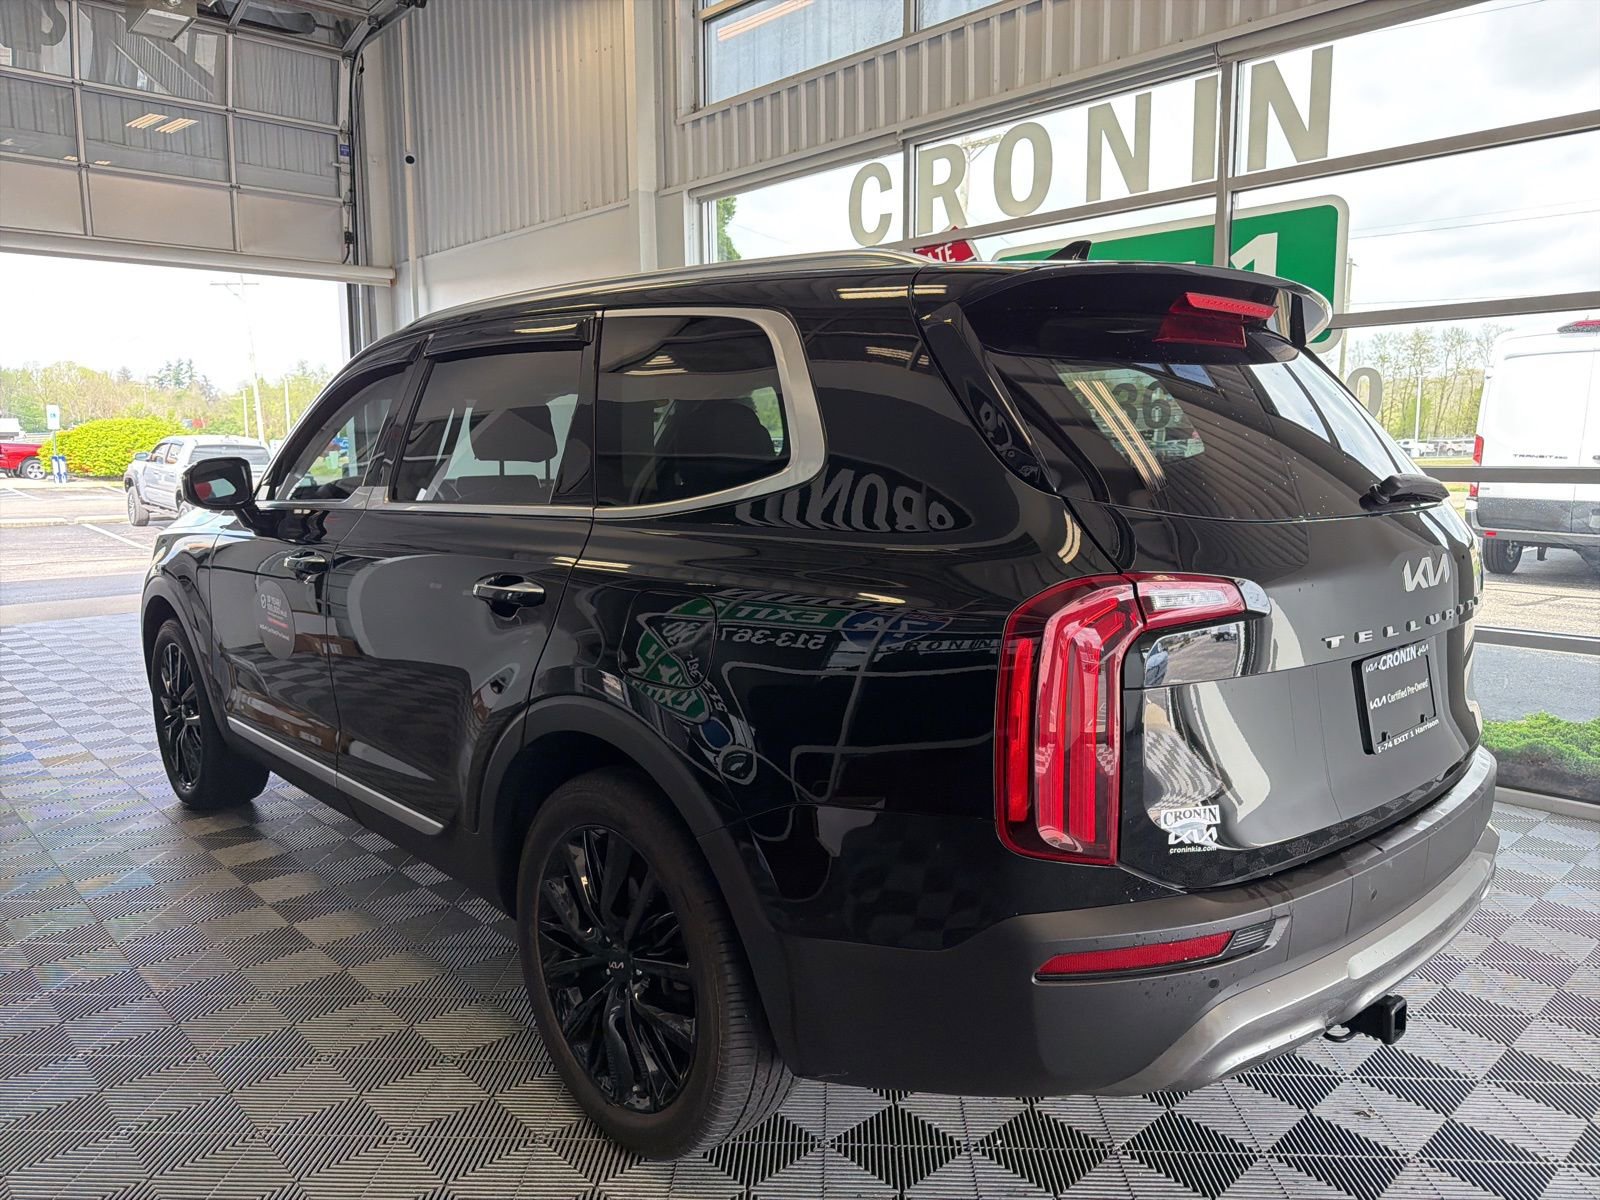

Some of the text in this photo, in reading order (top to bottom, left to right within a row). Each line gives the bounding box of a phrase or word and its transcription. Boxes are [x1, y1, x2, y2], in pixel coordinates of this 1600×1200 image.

[849, 45, 1333, 246] CRONIN
[1403, 553, 1450, 592] KIA
[1321, 597, 1478, 649] TELLURID
[1378, 645, 1417, 671] CRONIN
[1369, 678, 1429, 710] KIA Certified Pre-Owned
[1377, 741, 1393, 753] I-74
[1393, 732, 1409, 746] EXIT
[1415, 719, 1440, 735] Harrison
[1163, 807, 1217, 827] CRONIN
[1168, 826, 1218, 845] KIA
[1169, 846, 1217, 855] croninkia.com
